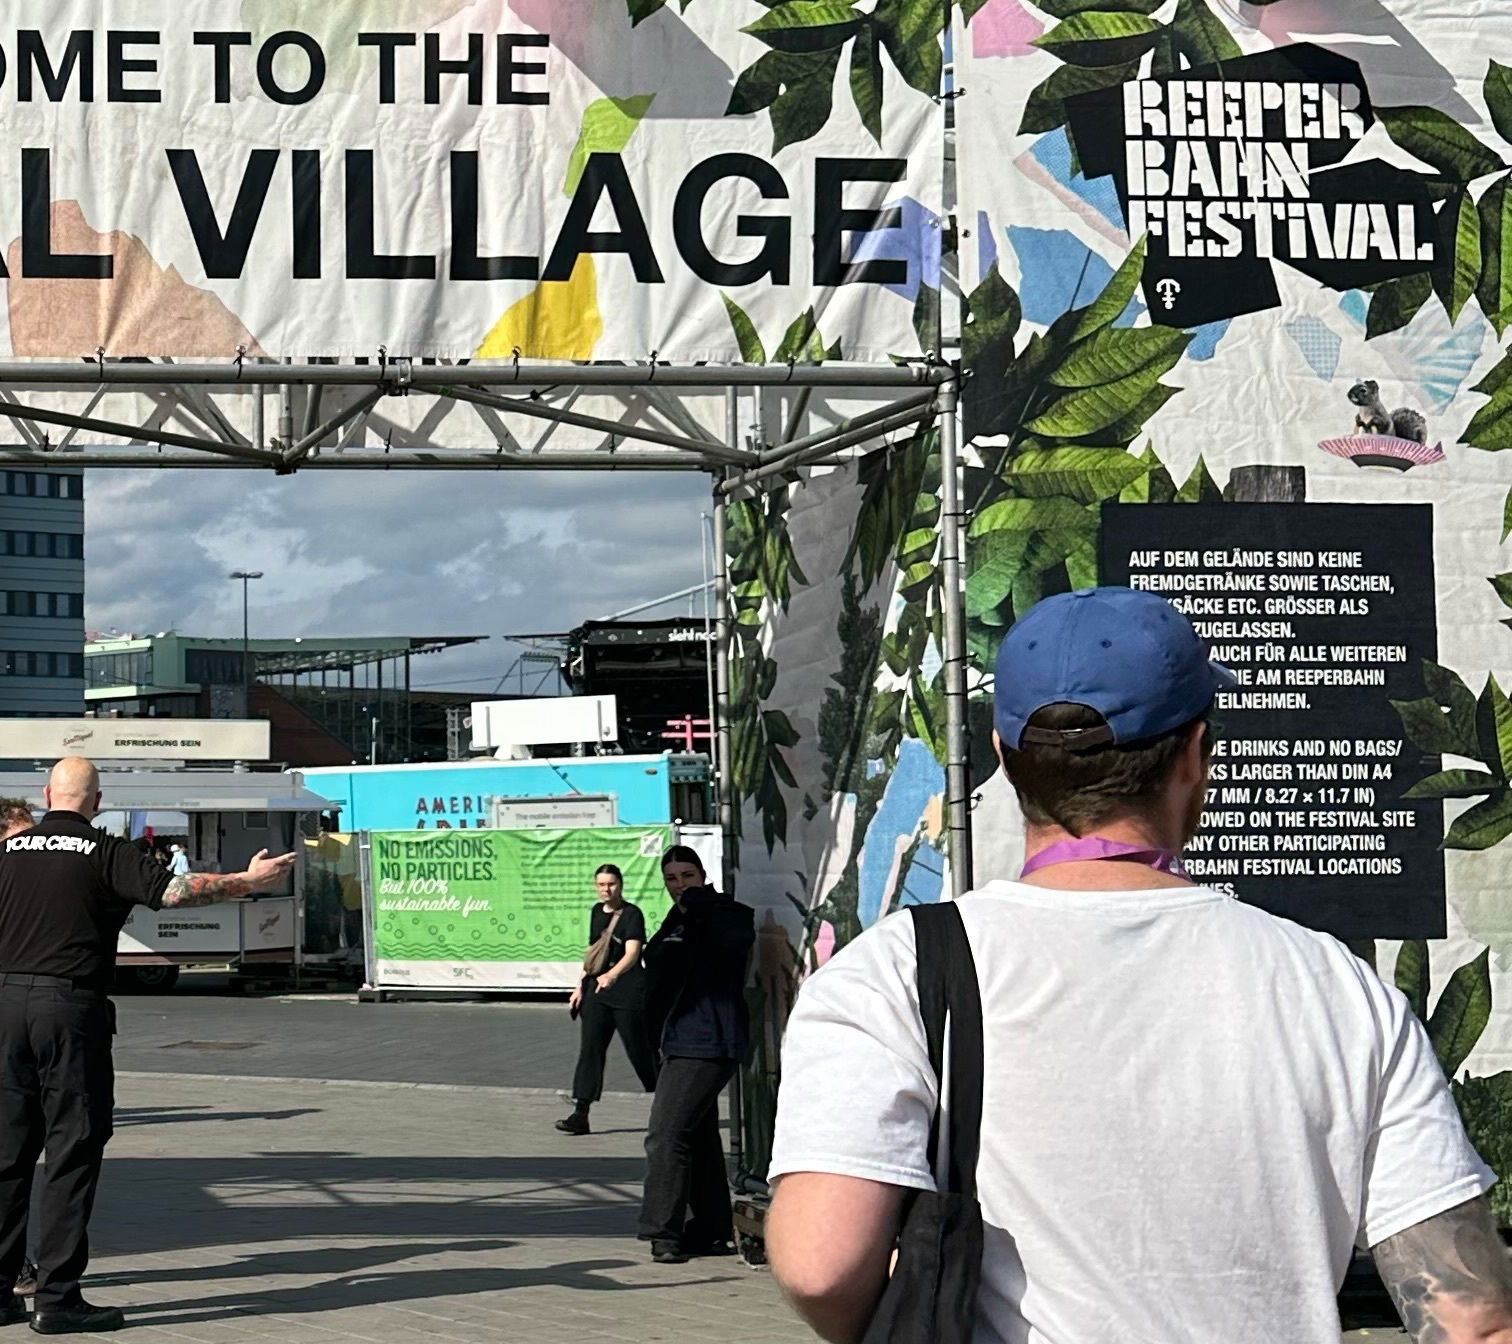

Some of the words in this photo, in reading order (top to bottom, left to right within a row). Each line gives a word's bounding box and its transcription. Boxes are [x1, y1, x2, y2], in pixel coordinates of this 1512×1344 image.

[193, 30, 326, 106] TO
[358, 32, 550, 106] THE
[1123, 80, 1364, 139] REEPER
[1126, 140, 1310, 198] BAHN
[165, 148, 908, 287] VILLAGE
[1128, 200, 1433, 260] FESTIVAL
[1129, 551, 1160, 567] AUF
[1165, 551, 1198, 567] DEM
[1203, 548, 1273, 567] GELÄNDE
[1277, 551, 1313, 567] SIND
[1318, 551, 1362, 568] KEINE
[1130, 572, 1265, 591] FREMDGETRÄNKE
[1269, 575, 1318, 591] SOWIE
[1322, 575, 1395, 594] TASCHEN,
[1168, 595, 1224, 614] SÄCKE
[1228, 598, 1261, 614] ETC.
[1265, 596, 1335, 614] GRÖSSER
[1340, 598, 1369, 614] ALS
[1192, 622, 1296, 638] ZUGELASSEN.
[1209, 645, 1251, 661] AUCH
[1256, 642, 1285, 661] FÜR
[1289, 645, 1327, 661] ALLE
[1331, 645, 1407, 662] WEITEREN
[1256, 669, 1281, 685] AM
[1285, 669, 1384, 686] REEPERBAHN
[1215, 692, 1310, 709] EILNEHMEN.
[114, 739, 178, 747] ERFRISCHUNG
[181, 739, 201, 747] SEIN
[1231, 740, 1289, 756] DRINKS
[1293, 740, 1325, 756] AND
[1330, 740, 1350, 756] NO
[1355, 739, 1402, 756] BAGS/
[1231, 764, 1292, 780] LARGER
[1297, 764, 1337, 780] THAN
[1342, 764, 1368, 780] DIN
[1373, 764, 1392, 780] A4
[416, 796, 485, 814] AMERI
[1222, 788, 1250, 804] MM
[1255, 788, 1262, 804] /
[1266, 788, 1298, 804] 8.27
[1318, 788, 1349, 804] 11.7
[1354, 788, 1375, 806] IN)
[1200, 811, 1245, 828] OWED
[1250, 811, 1271, 828] ON
[1275, 811, 1305, 827] THE
[1310, 811, 1379, 827] FESTIVAL
[1383, 811, 1415, 827] SITE
[6, 836, 46, 853] YOUR
[46, 835, 96, 855] CREW
[379, 840, 400, 859] NO
[406, 839, 498, 860] EMISSIONS,
[1219, 835, 1269, 851] OTHER
[1274, 835, 1385, 851] PARTICIPATING
[380, 862, 401, 881] NO
[406, 861, 497, 881] PARTICLES.
[1244, 859, 1314, 875] FESTIVAL
[1319, 858, 1402, 875] LOCATIONS
[379, 878, 404, 894] But
[407, 878, 448, 894] 100%
[379, 895, 461, 910] sustainable
[462, 896, 492, 919] fun.
[158, 922, 220, 930] ERFRISCHUNG
